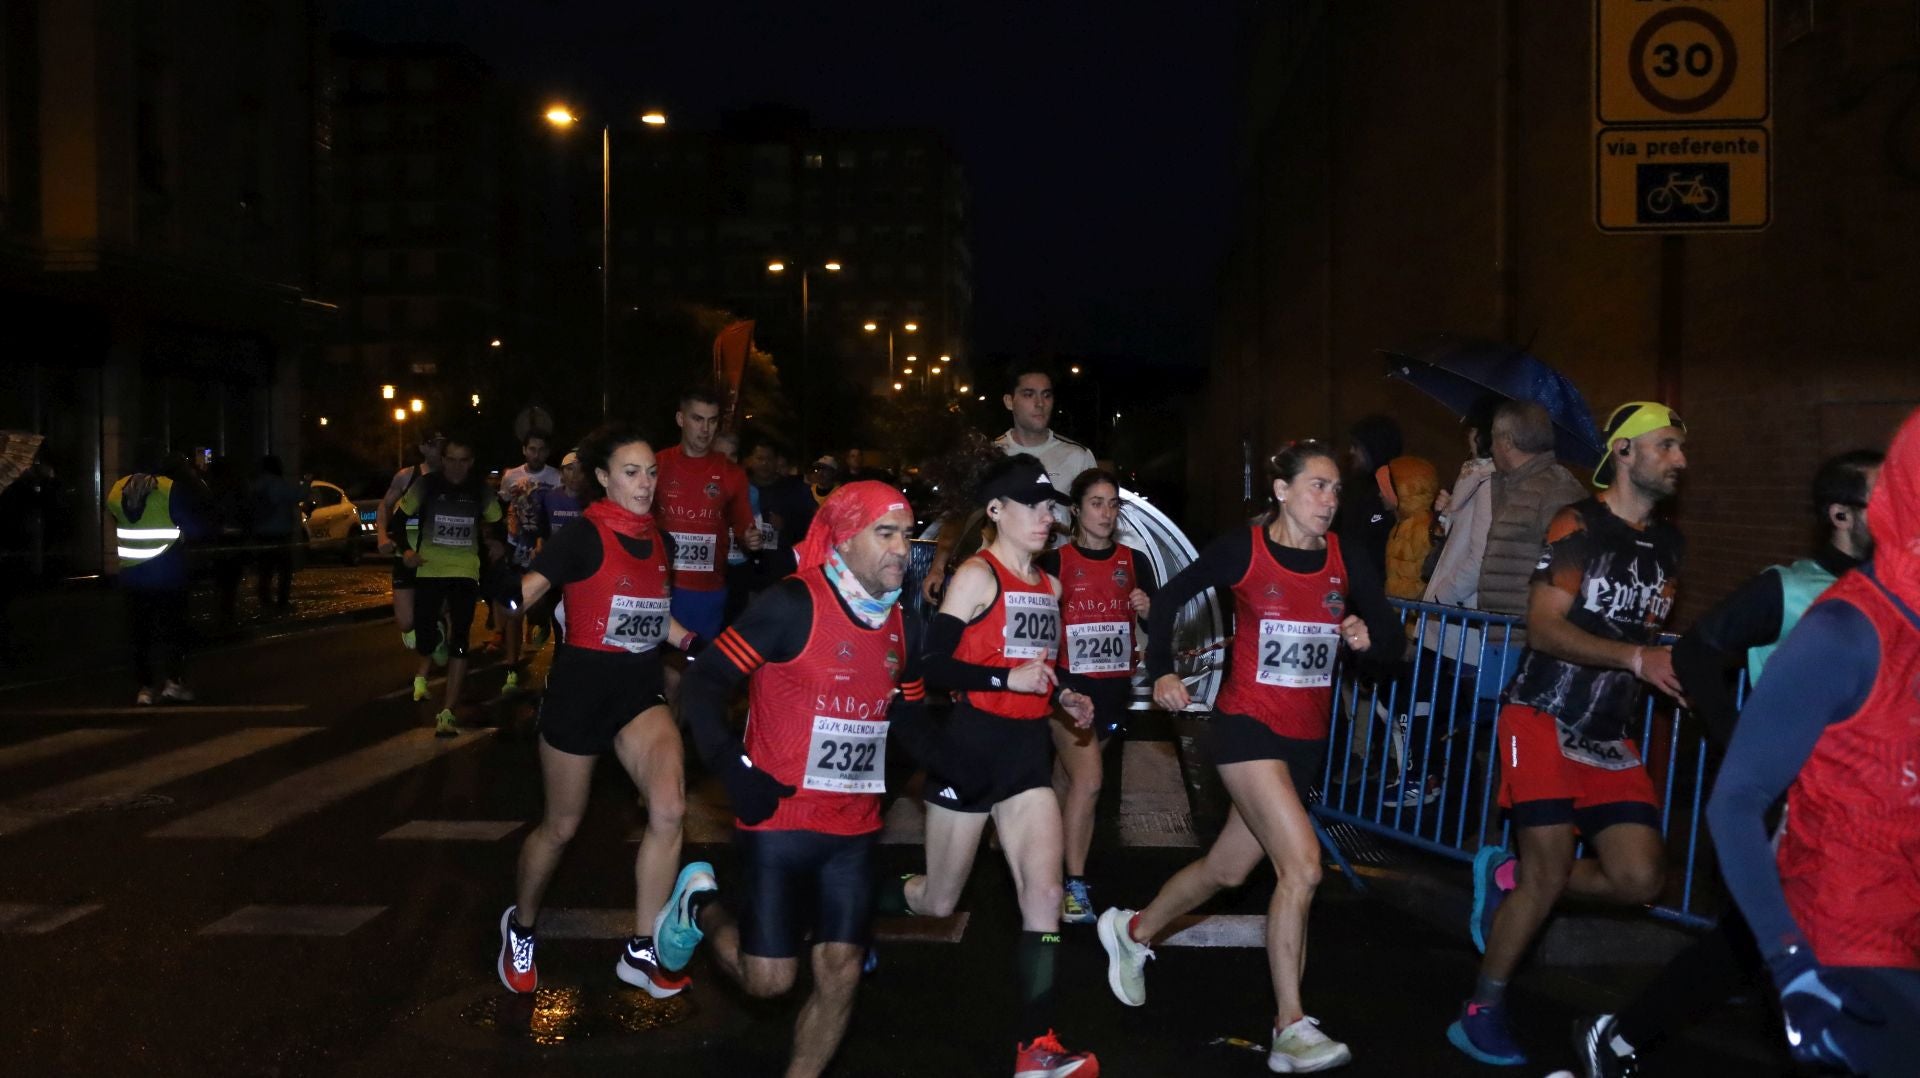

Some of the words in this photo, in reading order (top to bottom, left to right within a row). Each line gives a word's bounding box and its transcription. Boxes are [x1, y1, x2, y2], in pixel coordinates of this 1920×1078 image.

[1653, 43, 1713, 77] 30
[1606, 138, 1636, 155] via
[1646, 136, 1759, 157] preferente
[438, 526, 471, 537] 2470
[674, 544, 709, 560] 2239
[635, 600, 662, 609] PALENCIA
[615, 613, 664, 637] 2363
[1013, 612, 1057, 641] 2023
[1087, 625, 1115, 633] PALENCIA
[1287, 626, 1322, 635] PALENCIA
[1075, 637, 1123, 658] 2240
[1263, 640, 1329, 669] 2438
[842, 723, 875, 734] PALENCIA
[817, 739, 876, 772] 2322
